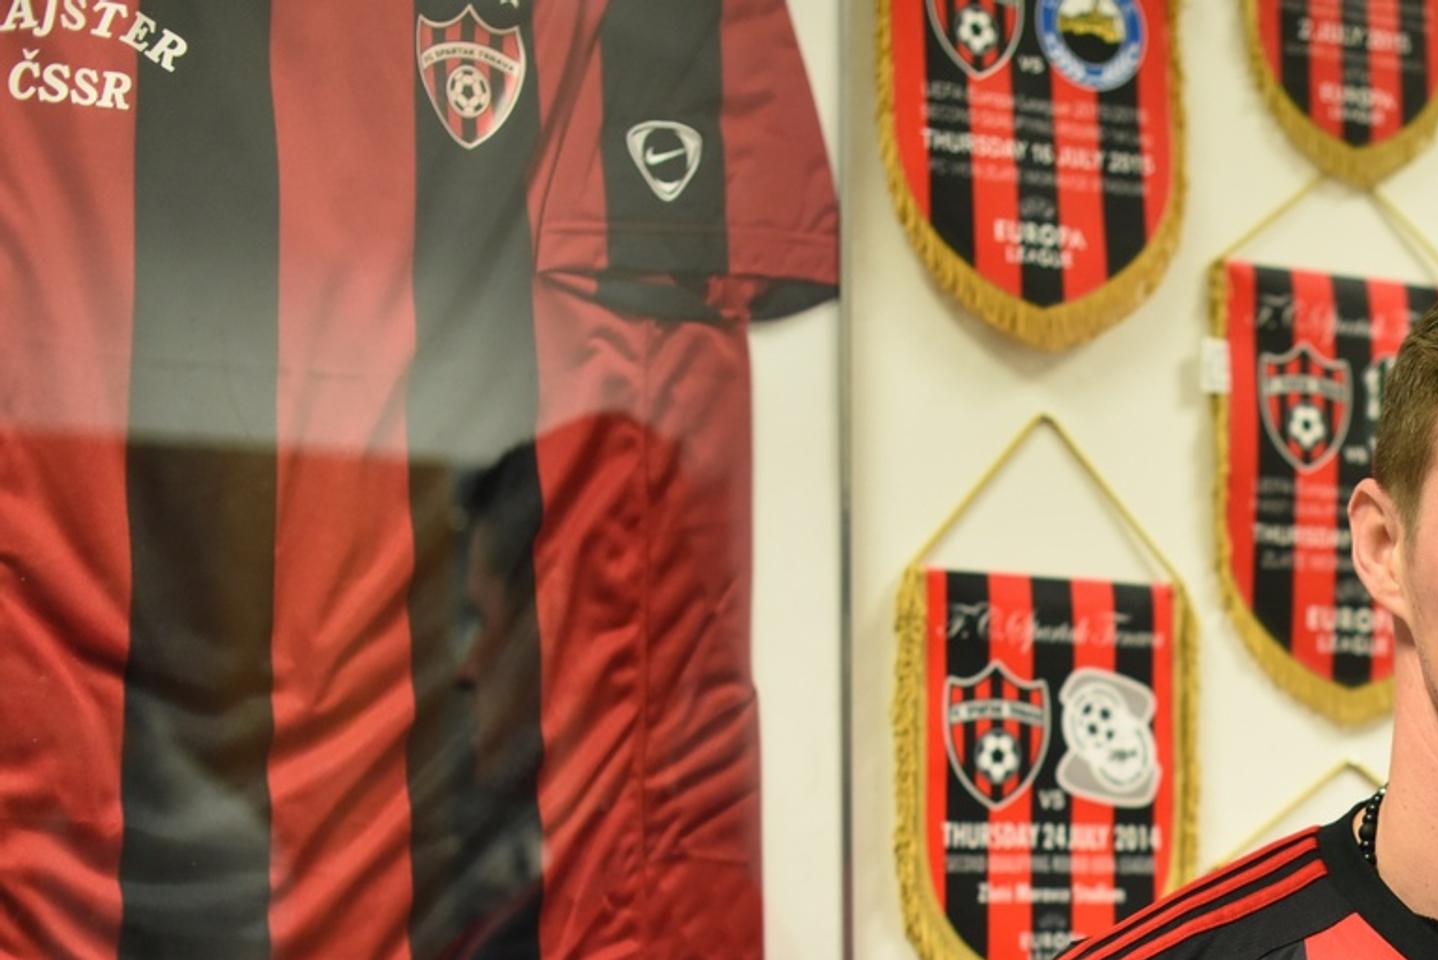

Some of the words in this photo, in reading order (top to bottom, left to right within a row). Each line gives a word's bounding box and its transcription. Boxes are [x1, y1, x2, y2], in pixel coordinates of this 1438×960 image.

[8, 48, 132, 110] ČSSR
[923, 127, 1027, 160] THURSDAY
[1030, 143, 1054, 166] 16
[1057, 146, 1103, 172] JULY
[1107, 153, 1156, 177] 2015
[994, 218, 1087, 250] EUROPA
[1005, 245, 1073, 268] LEAGUE
[1307, 604, 1391, 633] EUROP
[942, 821, 1040, 852] THURSDAY
